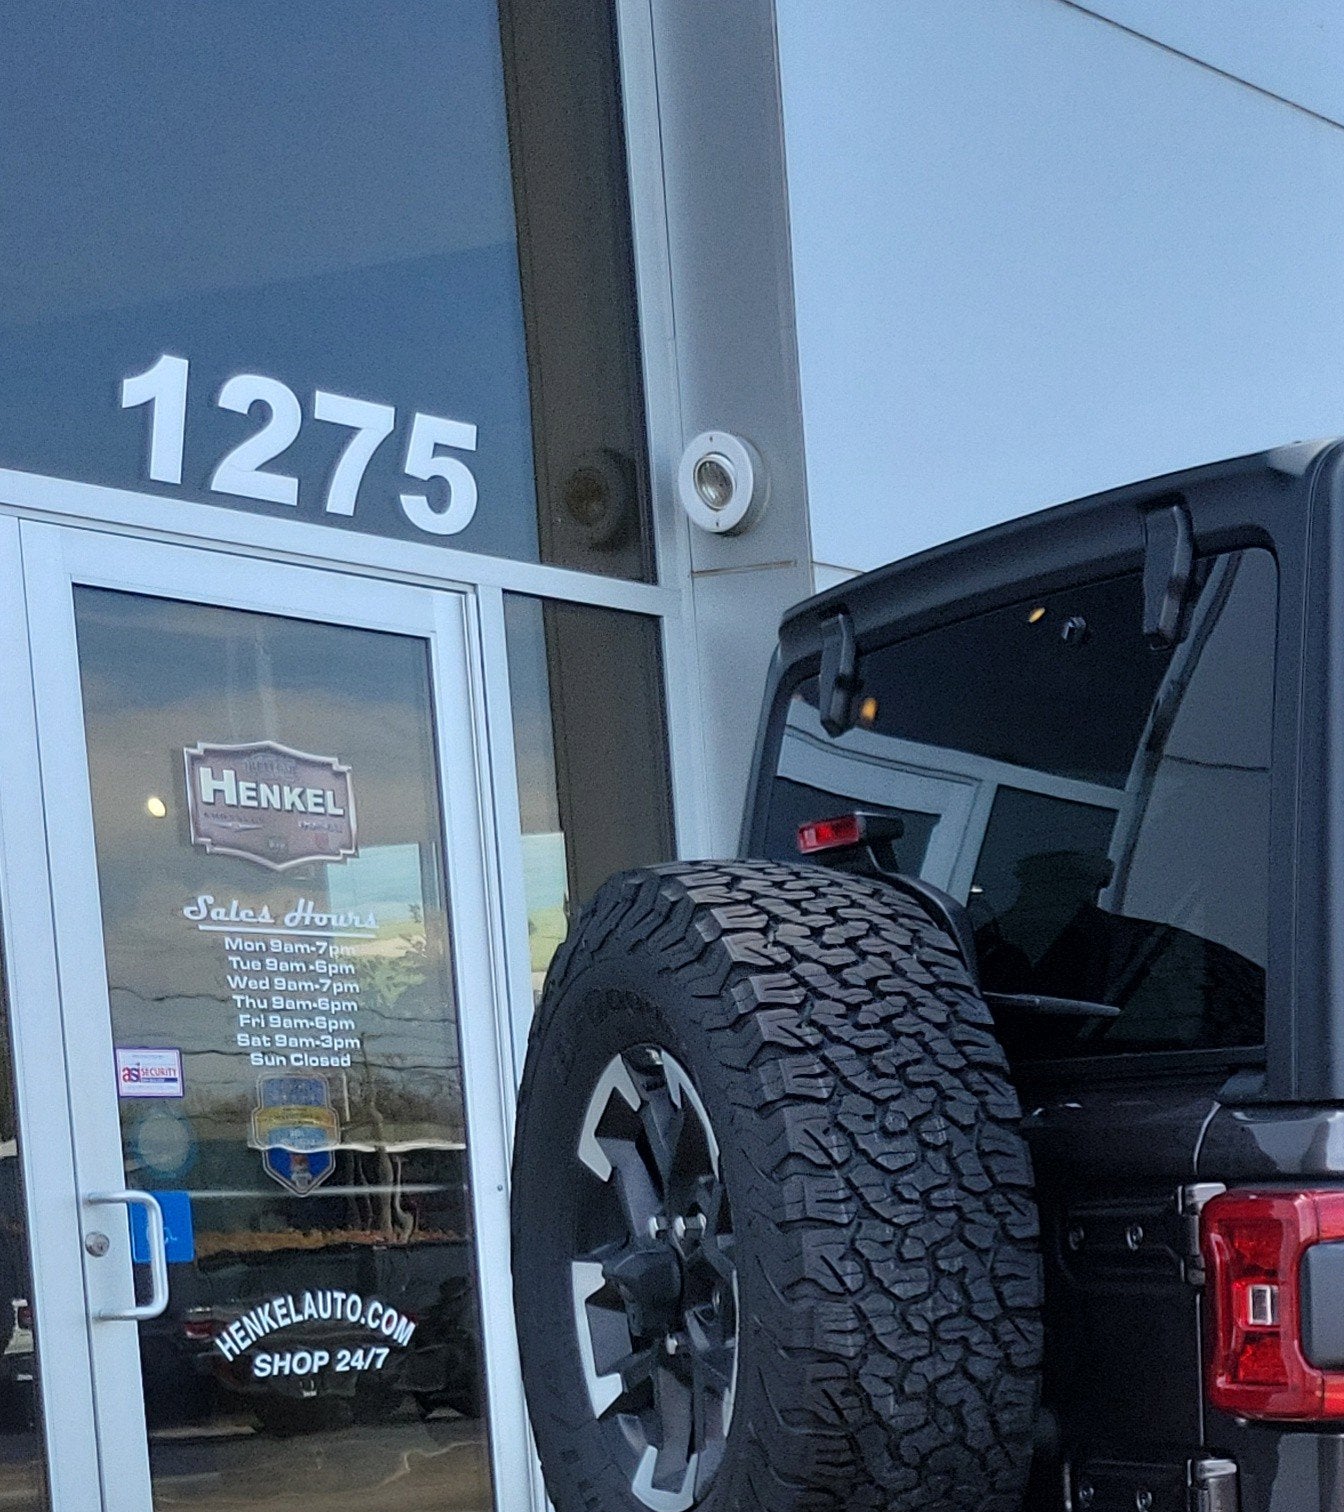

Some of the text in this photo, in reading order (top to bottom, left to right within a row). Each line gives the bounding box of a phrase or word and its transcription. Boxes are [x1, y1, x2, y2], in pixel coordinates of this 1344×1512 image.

[122, 354, 478, 536] 1275
[199, 766, 345, 816] HENKEL
[183, 895, 379, 929] Sales Hours
[224, 937, 356, 959] Mon 9am-7pm
[228, 956, 262, 971] Tue
[227, 975, 360, 995] Wed 9am-7pm
[232, 995, 358, 1014] Thu 9am-6pm
[239, 1014, 355, 1032] Fri 9am-6pm
[237, 1033, 361, 1051] Sat 9am-3pm
[251, 1052, 351, 1068] Sun Closed
[141, 1067, 176, 1077] SECURITY
[214, 1289, 416, 1362] HENKELAUTO.COM
[253, 1347, 391, 1378] SHOP 24/7
